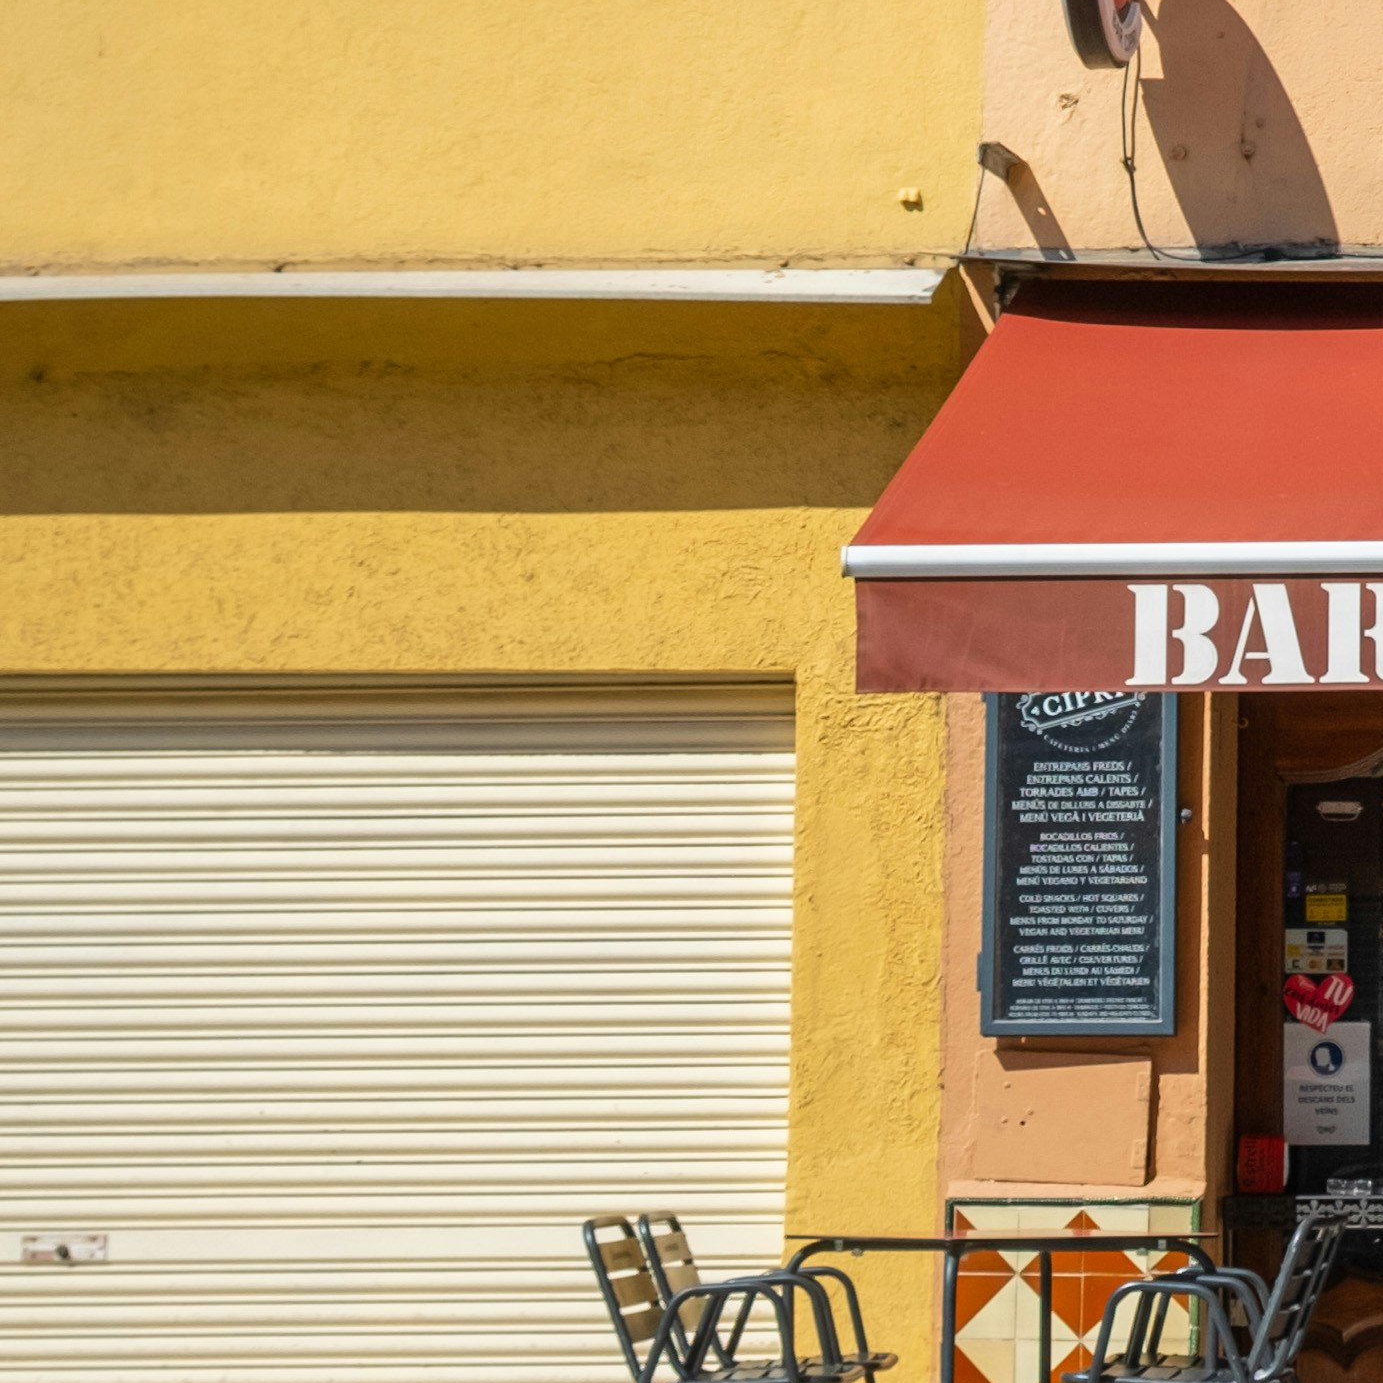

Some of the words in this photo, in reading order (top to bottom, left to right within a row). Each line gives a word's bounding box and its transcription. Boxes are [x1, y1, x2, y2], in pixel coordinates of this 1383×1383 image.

[1042, 691, 1126, 716] CIPR
[1033, 762, 1090, 772] ENTREPANS
[1093, 761, 1125, 771] FREDS
[1026, 775, 1083, 785] ENTREPANS
[1085, 774, 1131, 784] CALENTS
[1020, 787, 1073, 797] TORRADES
[1076, 787, 1099, 797] AMB
[1109, 786, 1138, 796] TAPES
[1011, 799, 1045, 810] MENÚS
[1048, 801, 1058, 810] DE
[1098, 801, 1104, 809] A
[1019, 810, 1048, 823] MENÚ
[1050, 811, 1079, 822] VEGÀ
[1031, 855, 1074, 863] TOSTADAS
[1076, 854, 1094, 863] CON
[1102, 854, 1127, 862] TAPAS
[1050, 866, 1060, 874] DE
[1090, 865, 1097, 873] A
[1080, 876, 1086, 885] Y
[1323, 974, 1354, 1006] TU
[1295, 1001, 1329, 1033] VIDA
